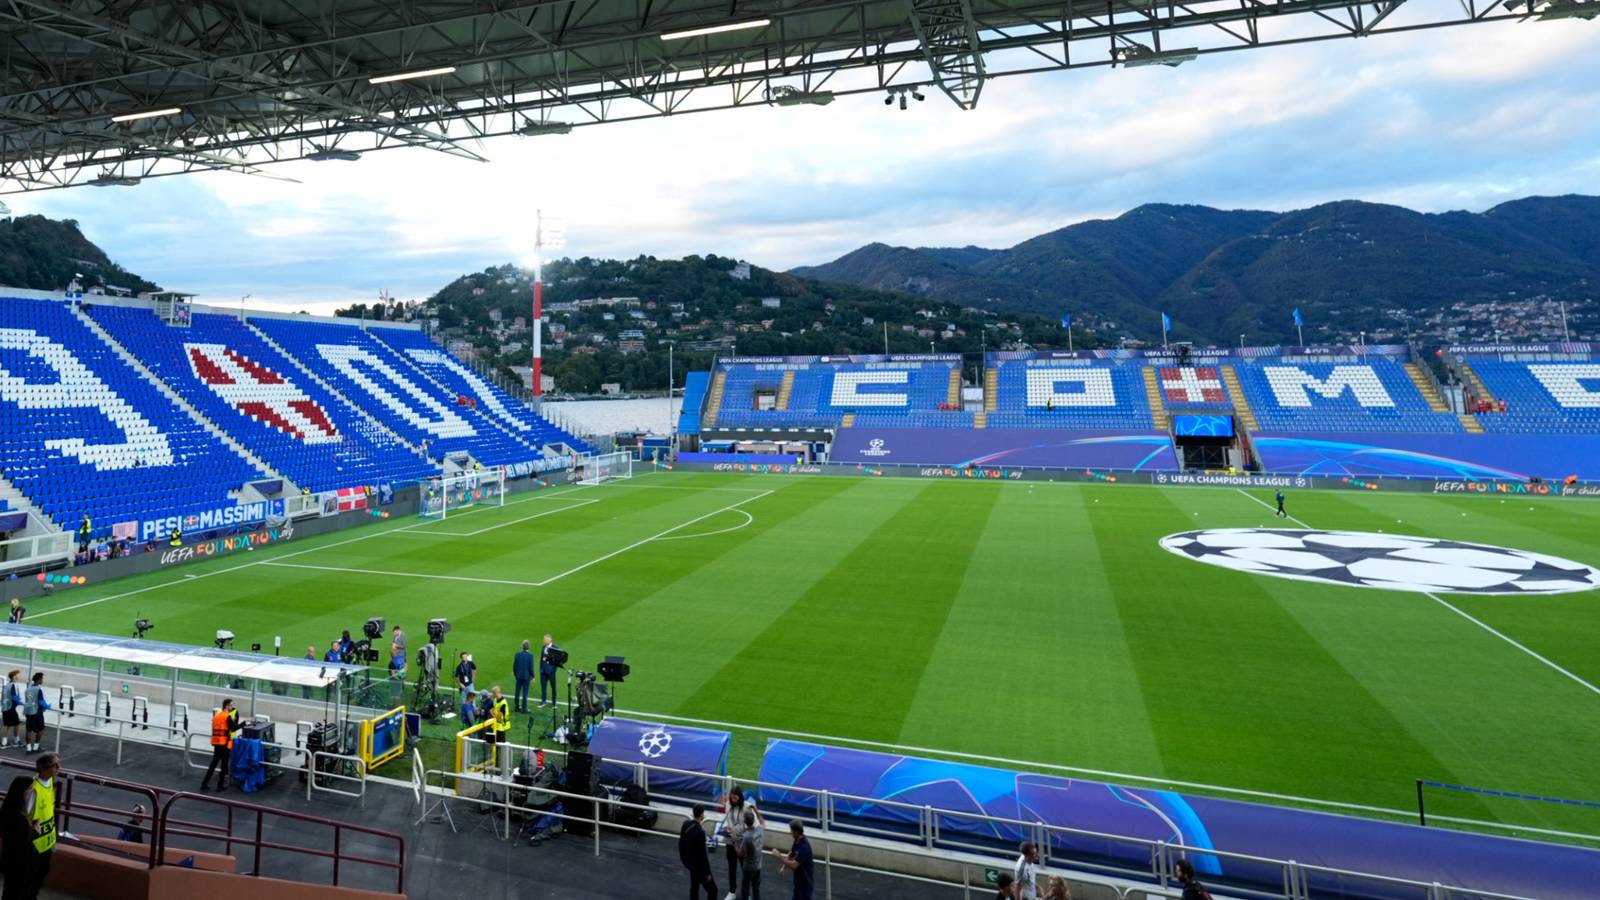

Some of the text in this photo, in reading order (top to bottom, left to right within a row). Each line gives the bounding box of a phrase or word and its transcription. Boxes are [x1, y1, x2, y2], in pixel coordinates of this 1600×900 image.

[921, 468, 943, 477] UEFA
[1171, 475, 1290, 486] UEFA CHAMPIONS LEAGUE
[1434, 481, 1465, 491] UEFA
[200, 503, 264, 529] MASSIMI
[161, 547, 195, 564] UEFA
